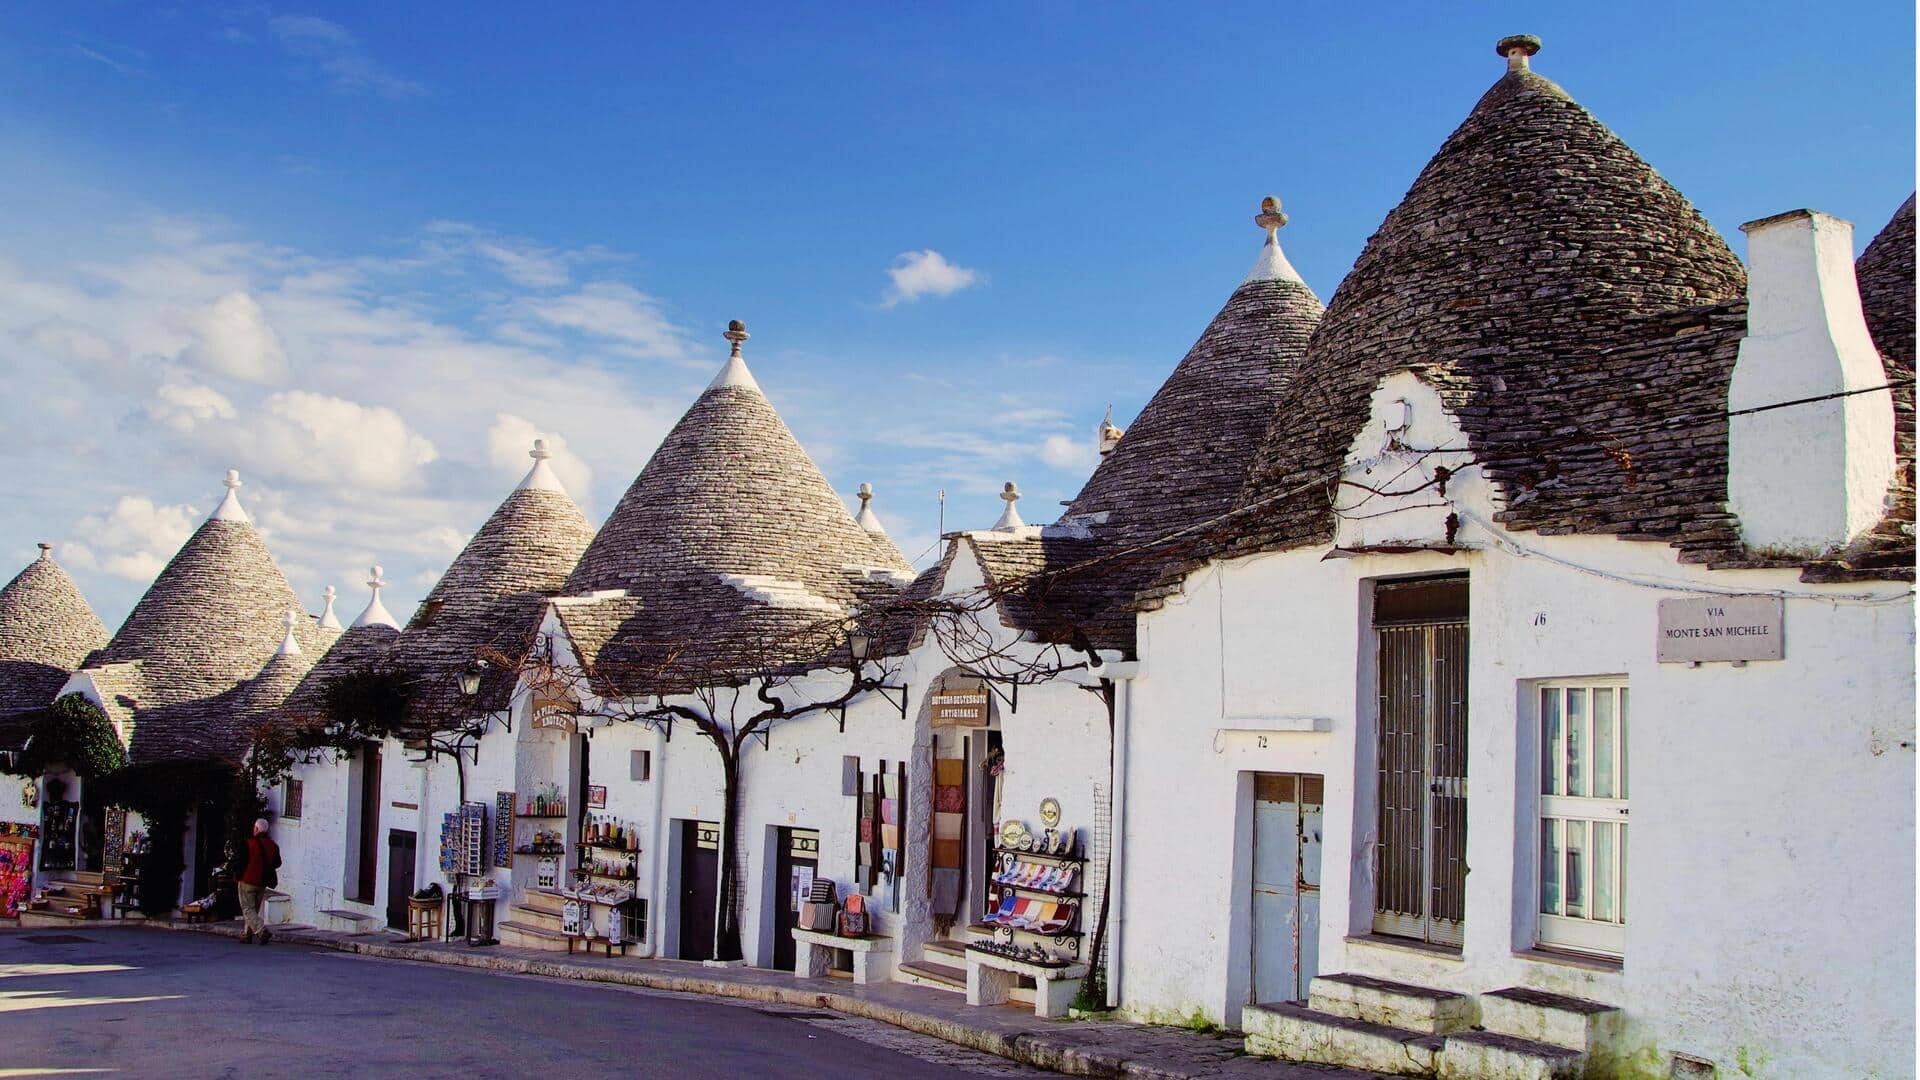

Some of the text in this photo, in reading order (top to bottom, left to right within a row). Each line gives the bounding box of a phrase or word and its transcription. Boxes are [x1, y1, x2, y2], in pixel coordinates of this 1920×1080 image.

[1707, 607, 1725, 617] VIA
[1534, 612, 1546, 626] 76
[1666, 626, 1769, 639] MONTE SAN MICHELE
[1257, 736, 1268, 748] 72
